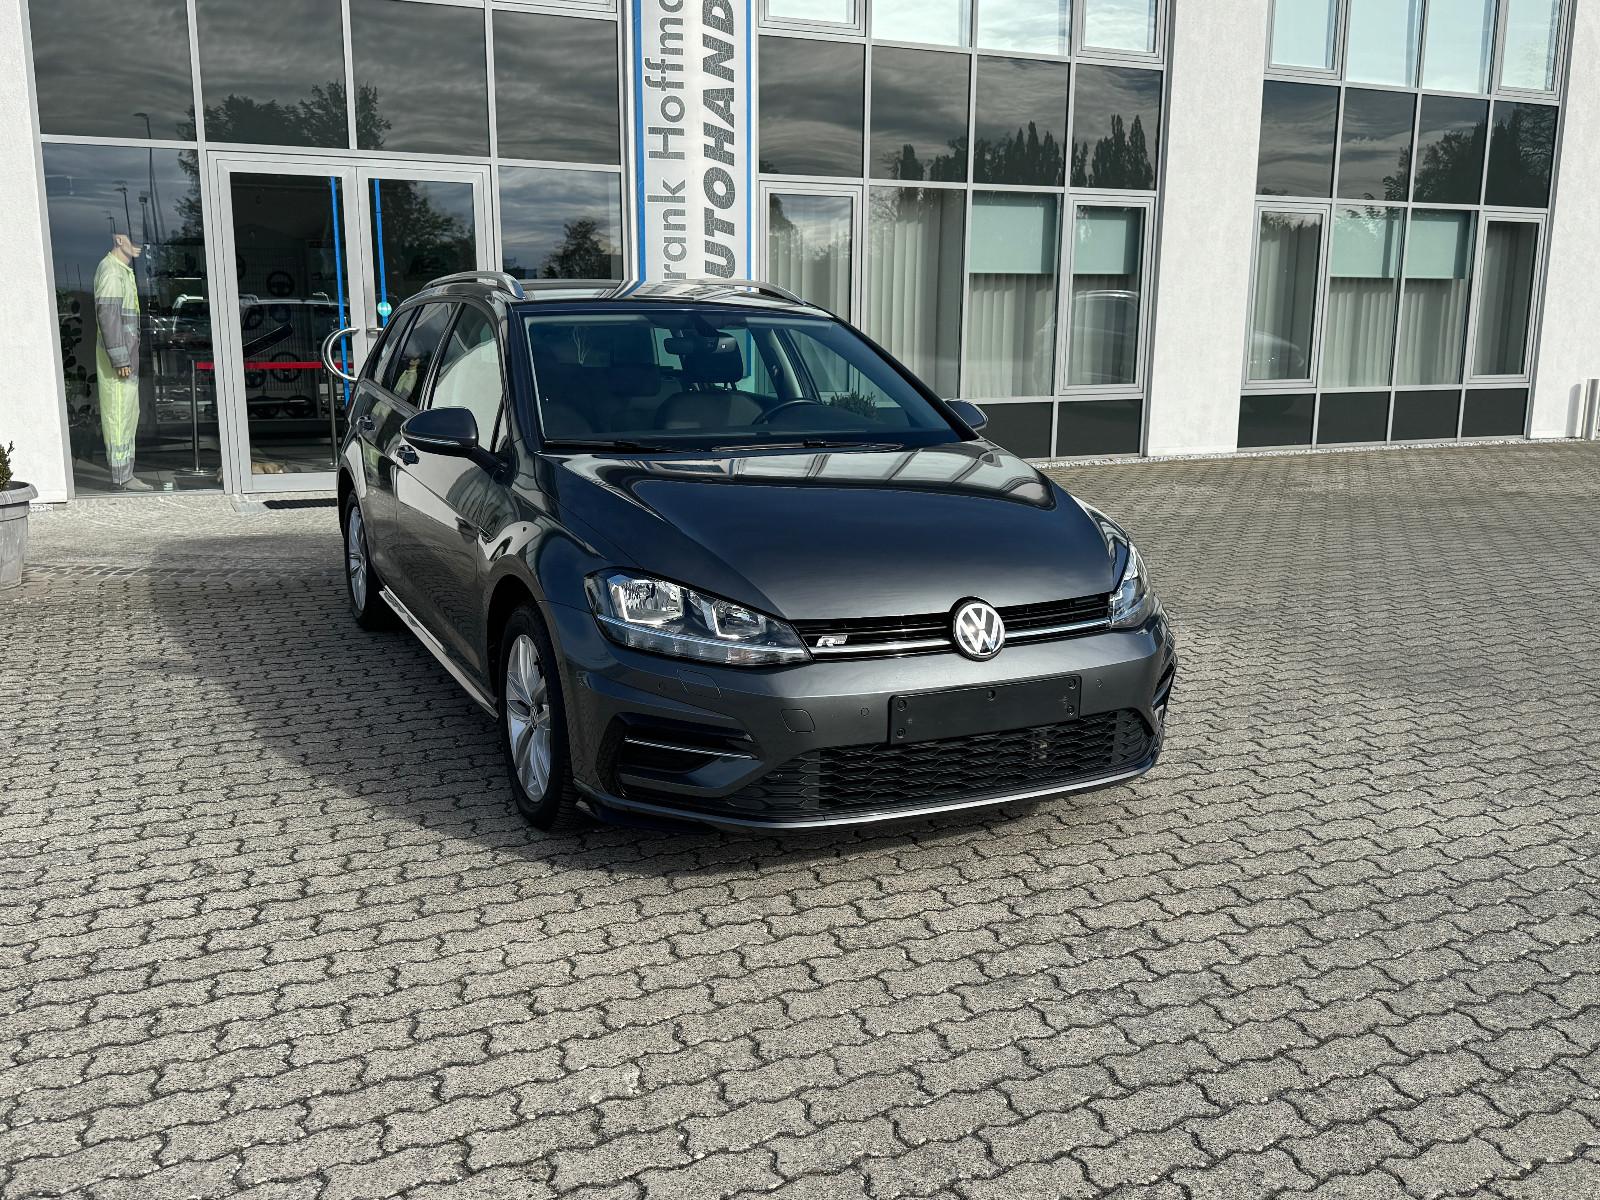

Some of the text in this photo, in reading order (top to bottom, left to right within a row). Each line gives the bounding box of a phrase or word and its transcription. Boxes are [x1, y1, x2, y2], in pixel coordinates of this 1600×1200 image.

[702, 0, 735, 279] UTOHAND
[647, 179, 687, 279] rank
[956, 603, 1005, 655] VW
